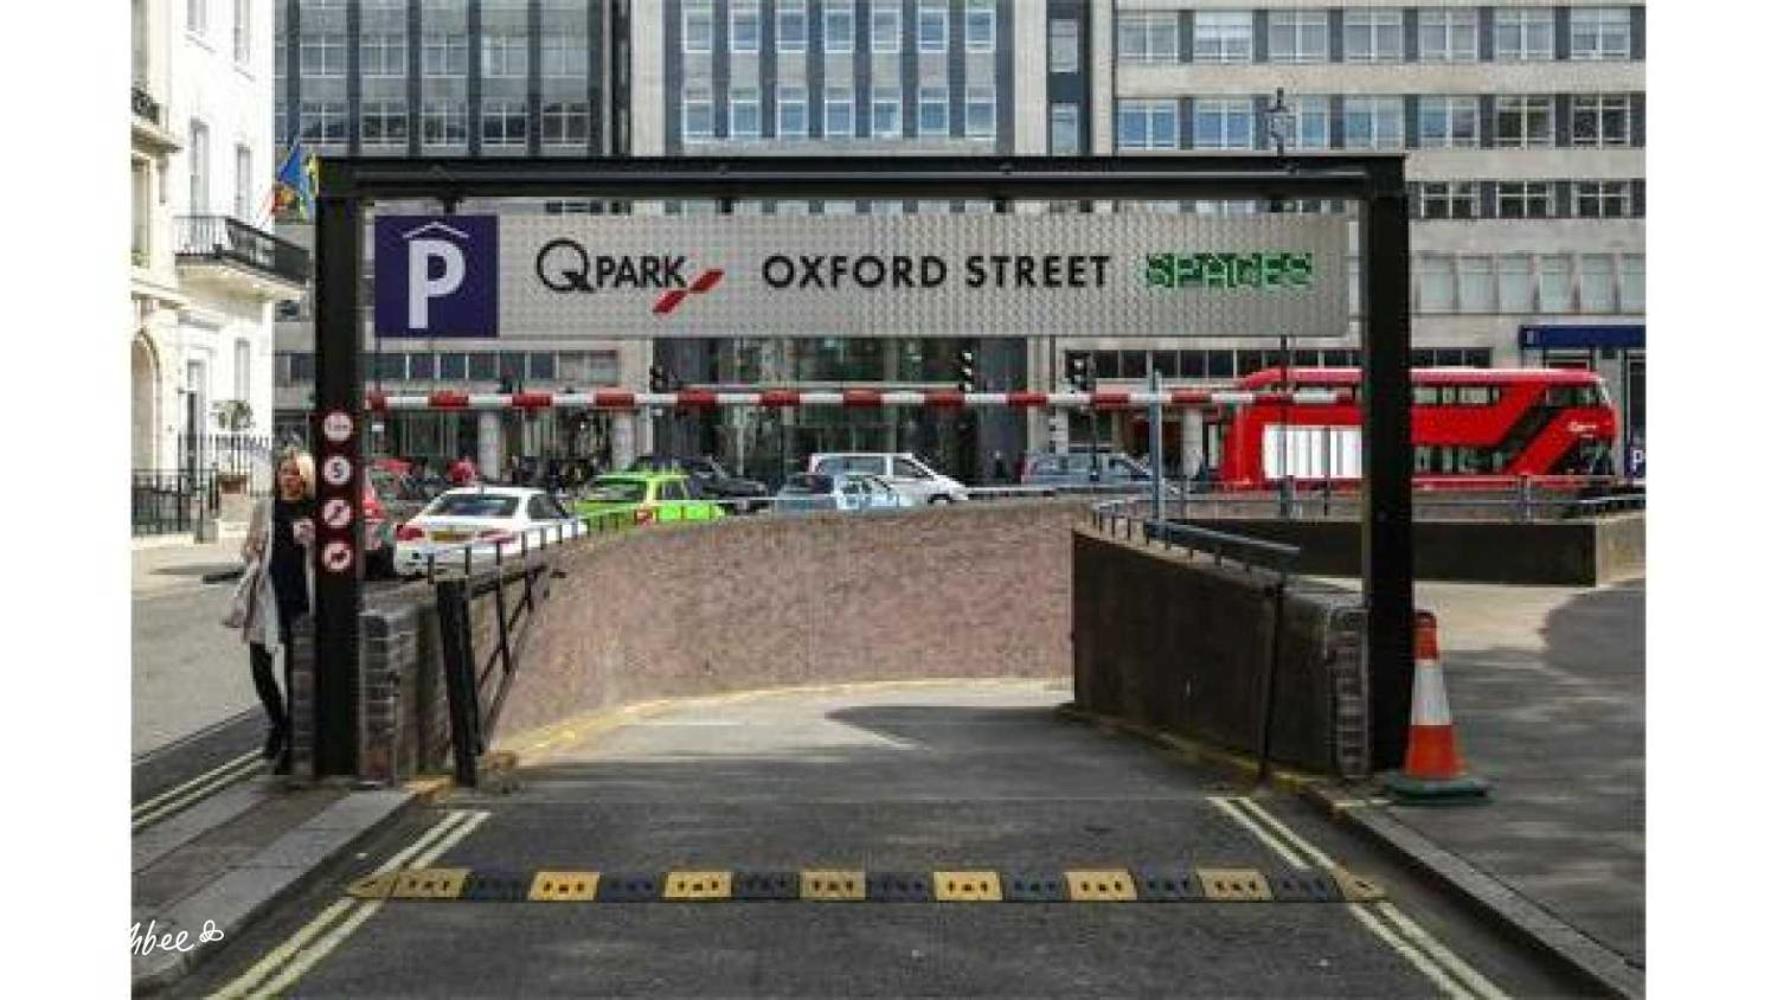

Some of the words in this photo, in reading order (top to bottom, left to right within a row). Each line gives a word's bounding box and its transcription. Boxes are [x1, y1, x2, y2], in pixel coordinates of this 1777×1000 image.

[409, 240, 466, 328] P
[762, 255, 947, 288] OXFORD
[965, 255, 1111, 288] STREET
[1144, 253, 1313, 290] SPACES
